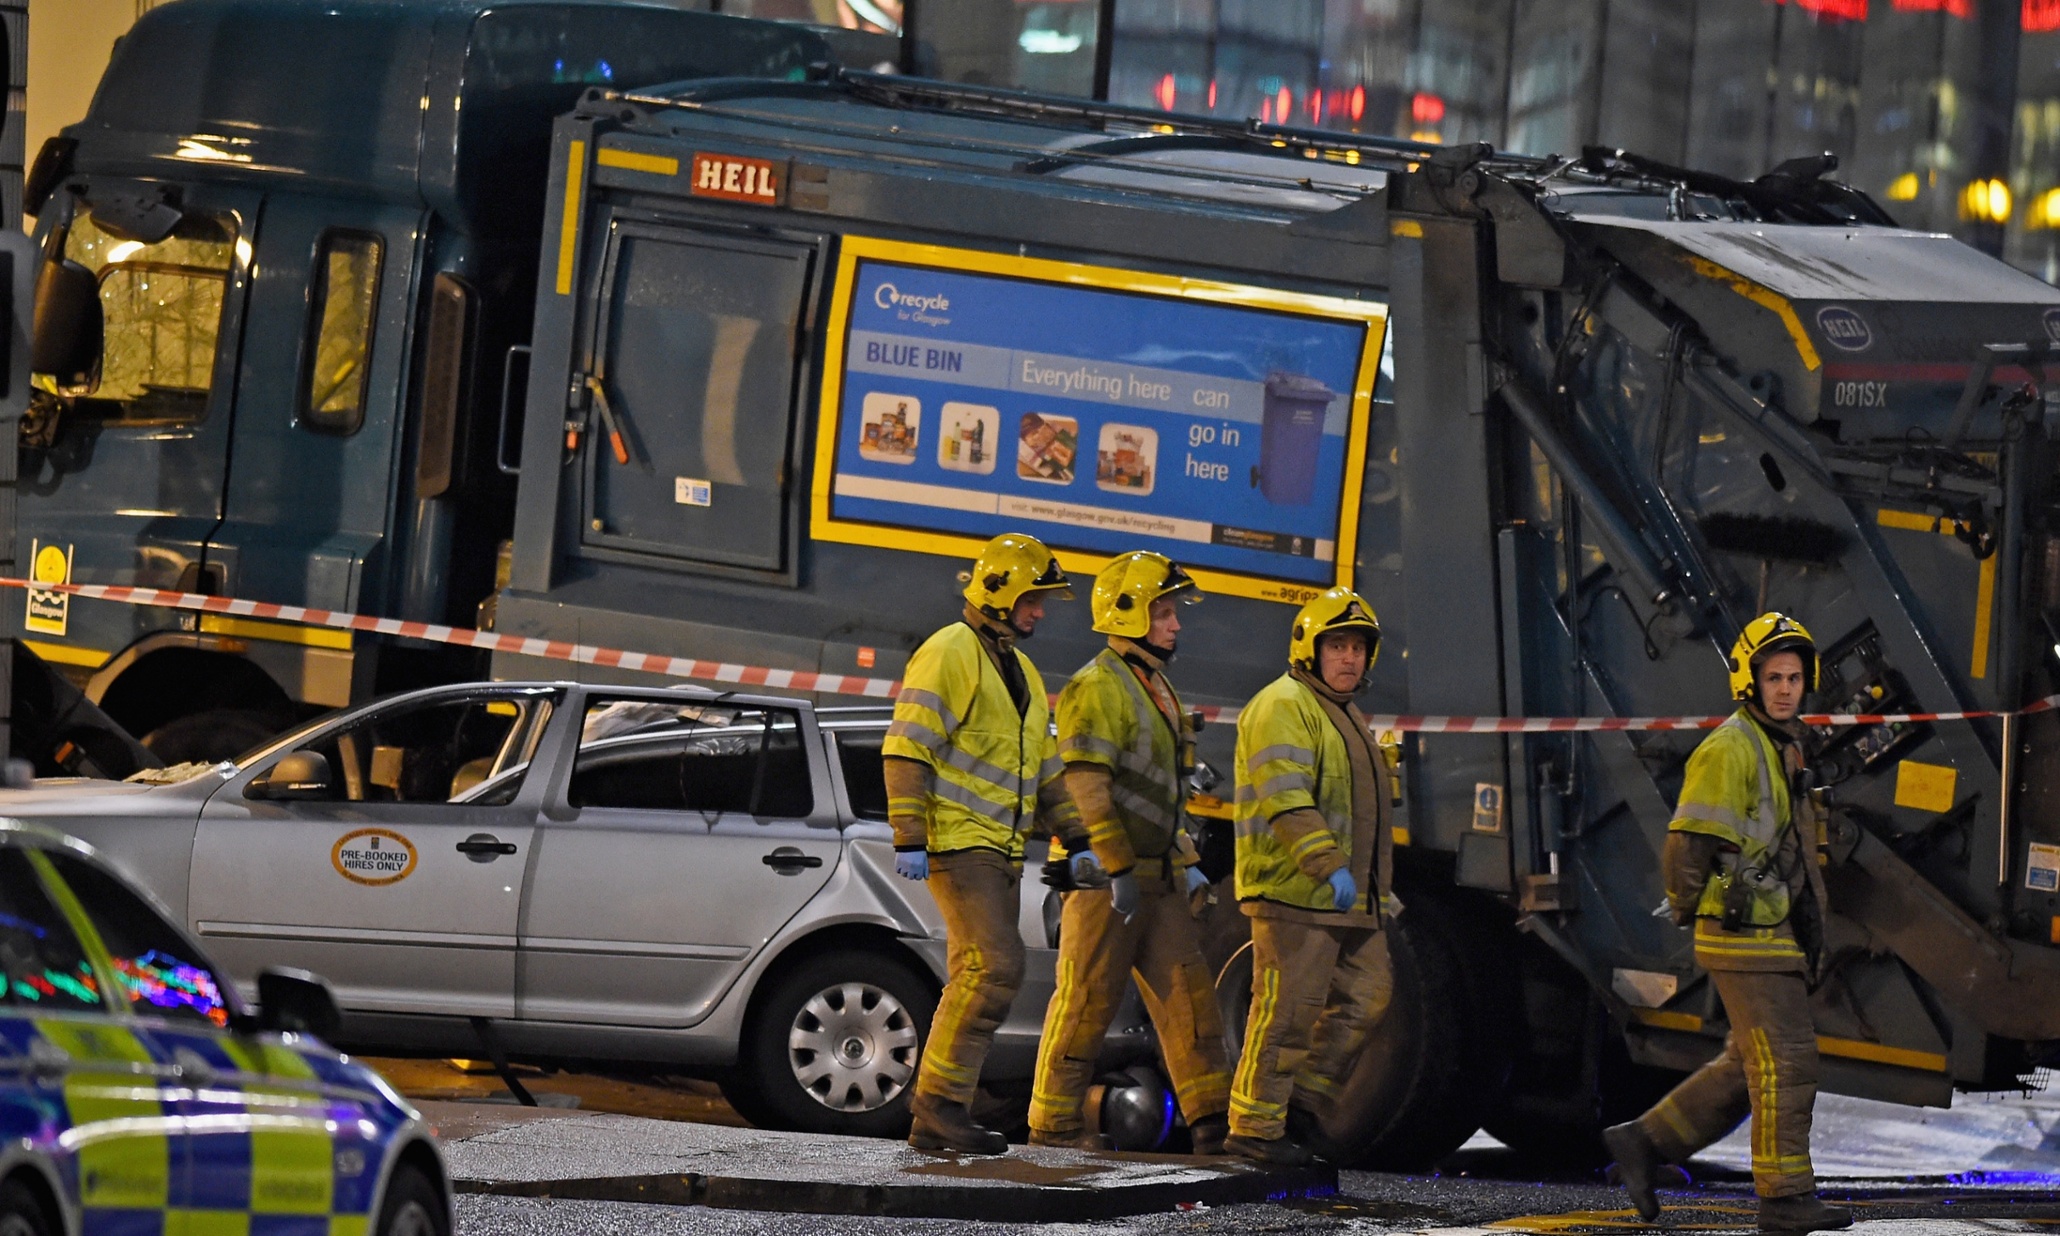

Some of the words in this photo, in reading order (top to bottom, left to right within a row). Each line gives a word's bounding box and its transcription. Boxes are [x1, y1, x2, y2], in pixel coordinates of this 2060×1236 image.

[698, 160, 775, 196] HEIL
[901, 293, 949, 312] recycle
[1823, 318, 1867, 339] HEIL
[866, 341, 920, 368] BLUE
[926, 348, 962, 373] BIN
[1022, 359, 1122, 400] Everything
[1128, 373, 1171, 401] here
[1193, 388, 1230, 409] can
[1834, 381, 1887, 407] 081SX
[1189, 423, 1215, 448] go
[1222, 422, 1240, 447] in
[1185, 453, 1229, 481] here
[1031, 504, 1176, 534] www.glasgow.gov.uk/recycling
[341, 850, 407, 861] PRE-BOOKED
[344, 860, 374, 870] HIRES
[376, 861, 403, 871] ONLY
